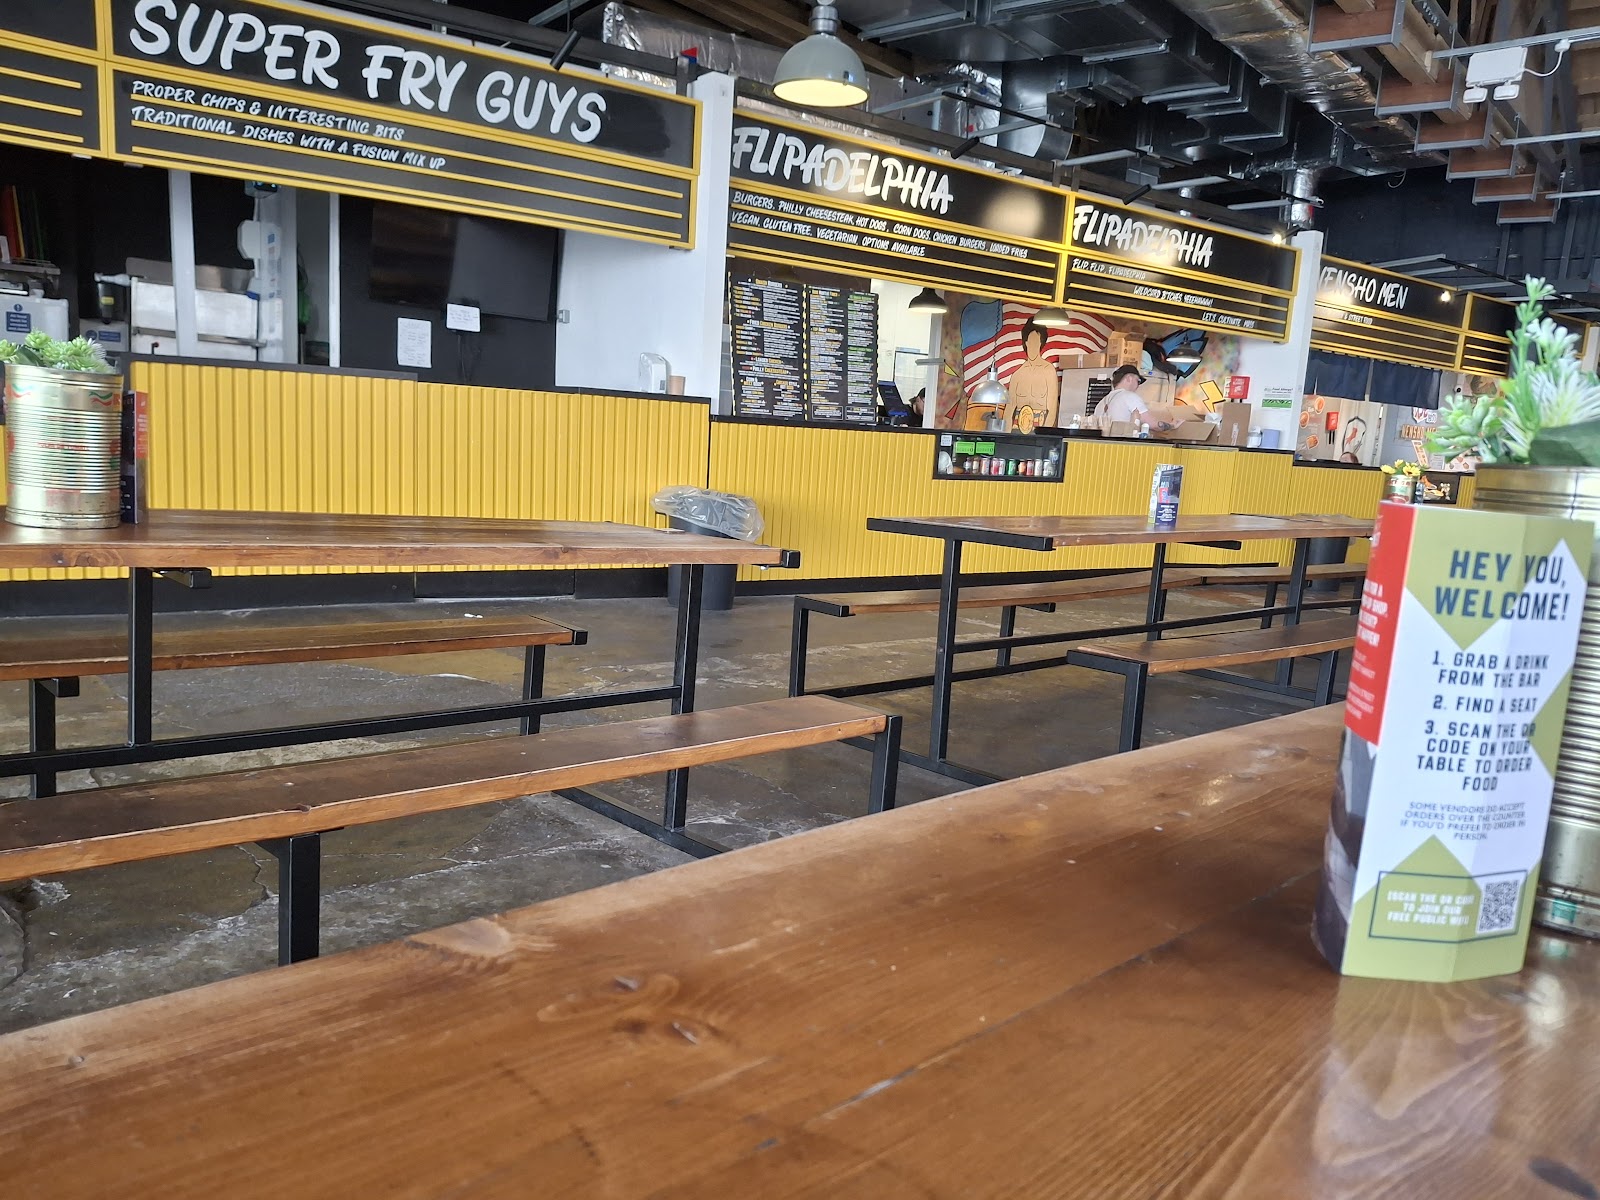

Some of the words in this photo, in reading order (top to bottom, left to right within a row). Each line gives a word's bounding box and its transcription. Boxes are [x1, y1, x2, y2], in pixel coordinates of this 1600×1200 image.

[130, 0, 342, 90] SUPER
[361, 44, 469, 112] FRY
[475, 70, 607, 143] GUYS
[132, 80, 196, 104] PROPER
[200, 92, 246, 113] CHIPS
[249, 101, 261, 115] &
[267, 105, 370, 135] INTERESTING
[372, 124, 405, 141] BITS
[131, 106, 236, 135] TRADITIONAL
[242, 125, 295, 145] DISHES
[300, 133, 335, 152] WITH
[338, 141, 349, 153] A
[352, 143, 400, 162] FUSION
[402, 151, 425, 168] MIX
[428, 156, 447, 170] UP
[732, 126, 954, 215] FLIPADELPHIA
[763, 218, 791, 233] GLUTEN
[862, 236, 889, 251] OPTIONS
[891, 242, 926, 257] AVAILABLE
[778, 200, 804, 215] PHILLY
[856, 216, 870, 228] HOT
[893, 223, 913, 236] CORN
[933, 231, 957, 245] CHICKEN
[990, 242, 1010, 255] LOADED
[1011, 247, 1028, 259] FRIES
[1073, 205, 1213, 268] FLIPADELPHIA
[1108, 266, 1146, 280] FLIPADELPHIA
[1318, 266, 1376, 303] ENSHO
[1377, 281, 1408, 309] MEN
[1449, 549, 1513, 583] HEY
[1524, 554, 1566, 588] YOU,
[1434, 585, 1571, 621] WELCOME!
[1432, 650, 1444, 666] 1.
[1453, 652, 1498, 670] GRAB
[1504, 655, 1512, 670] A
[1514, 655, 1550, 670] DRINK
[1438, 669, 1485, 687] FROM
[1494, 673, 1515, 688] THE
[1518, 673, 1541, 688] BAR
[1432, 694, 1447, 710] 2.
[1456, 696, 1495, 713] FIND
[1498, 698, 1506, 713] A
[1510, 697, 1538, 712] SEAT
[1424, 719, 1439, 735] 3.
[1447, 721, 1492, 739] SCAN
[1497, 723, 1517, 738] THE
[1521, 722, 1537, 737] QR
[1427, 738, 1471, 755] CODE
[1479, 741, 1497, 756] ON
[1502, 739, 1531, 756] YOUR
[1417, 754, 1466, 773] TABLE
[1475, 759, 1491, 774] TO
[1495, 757, 1533, 773] ORDER
[1462, 775, 1499, 791] FOOD
[1405, 810, 1445, 821] ORDERS
[1448, 813, 1475, 822] OVER
[1477, 813, 1490, 822] THE
[1409, 801, 1438, 811] SOME
[1440, 803, 1485, 813] VENDORS
[1400, 819, 1409, 827] IF
[1412, 820, 1445, 830] YOU'D
[1447, 822, 1481, 831] PREFER
[1453, 832, 1489, 840] PERSON
[1403, 902, 1415, 912] TO
[1420, 893, 1437, 903] THE
[1387, 911, 1411, 922] FREE
[1412, 913, 1449, 925] PUBLIC
